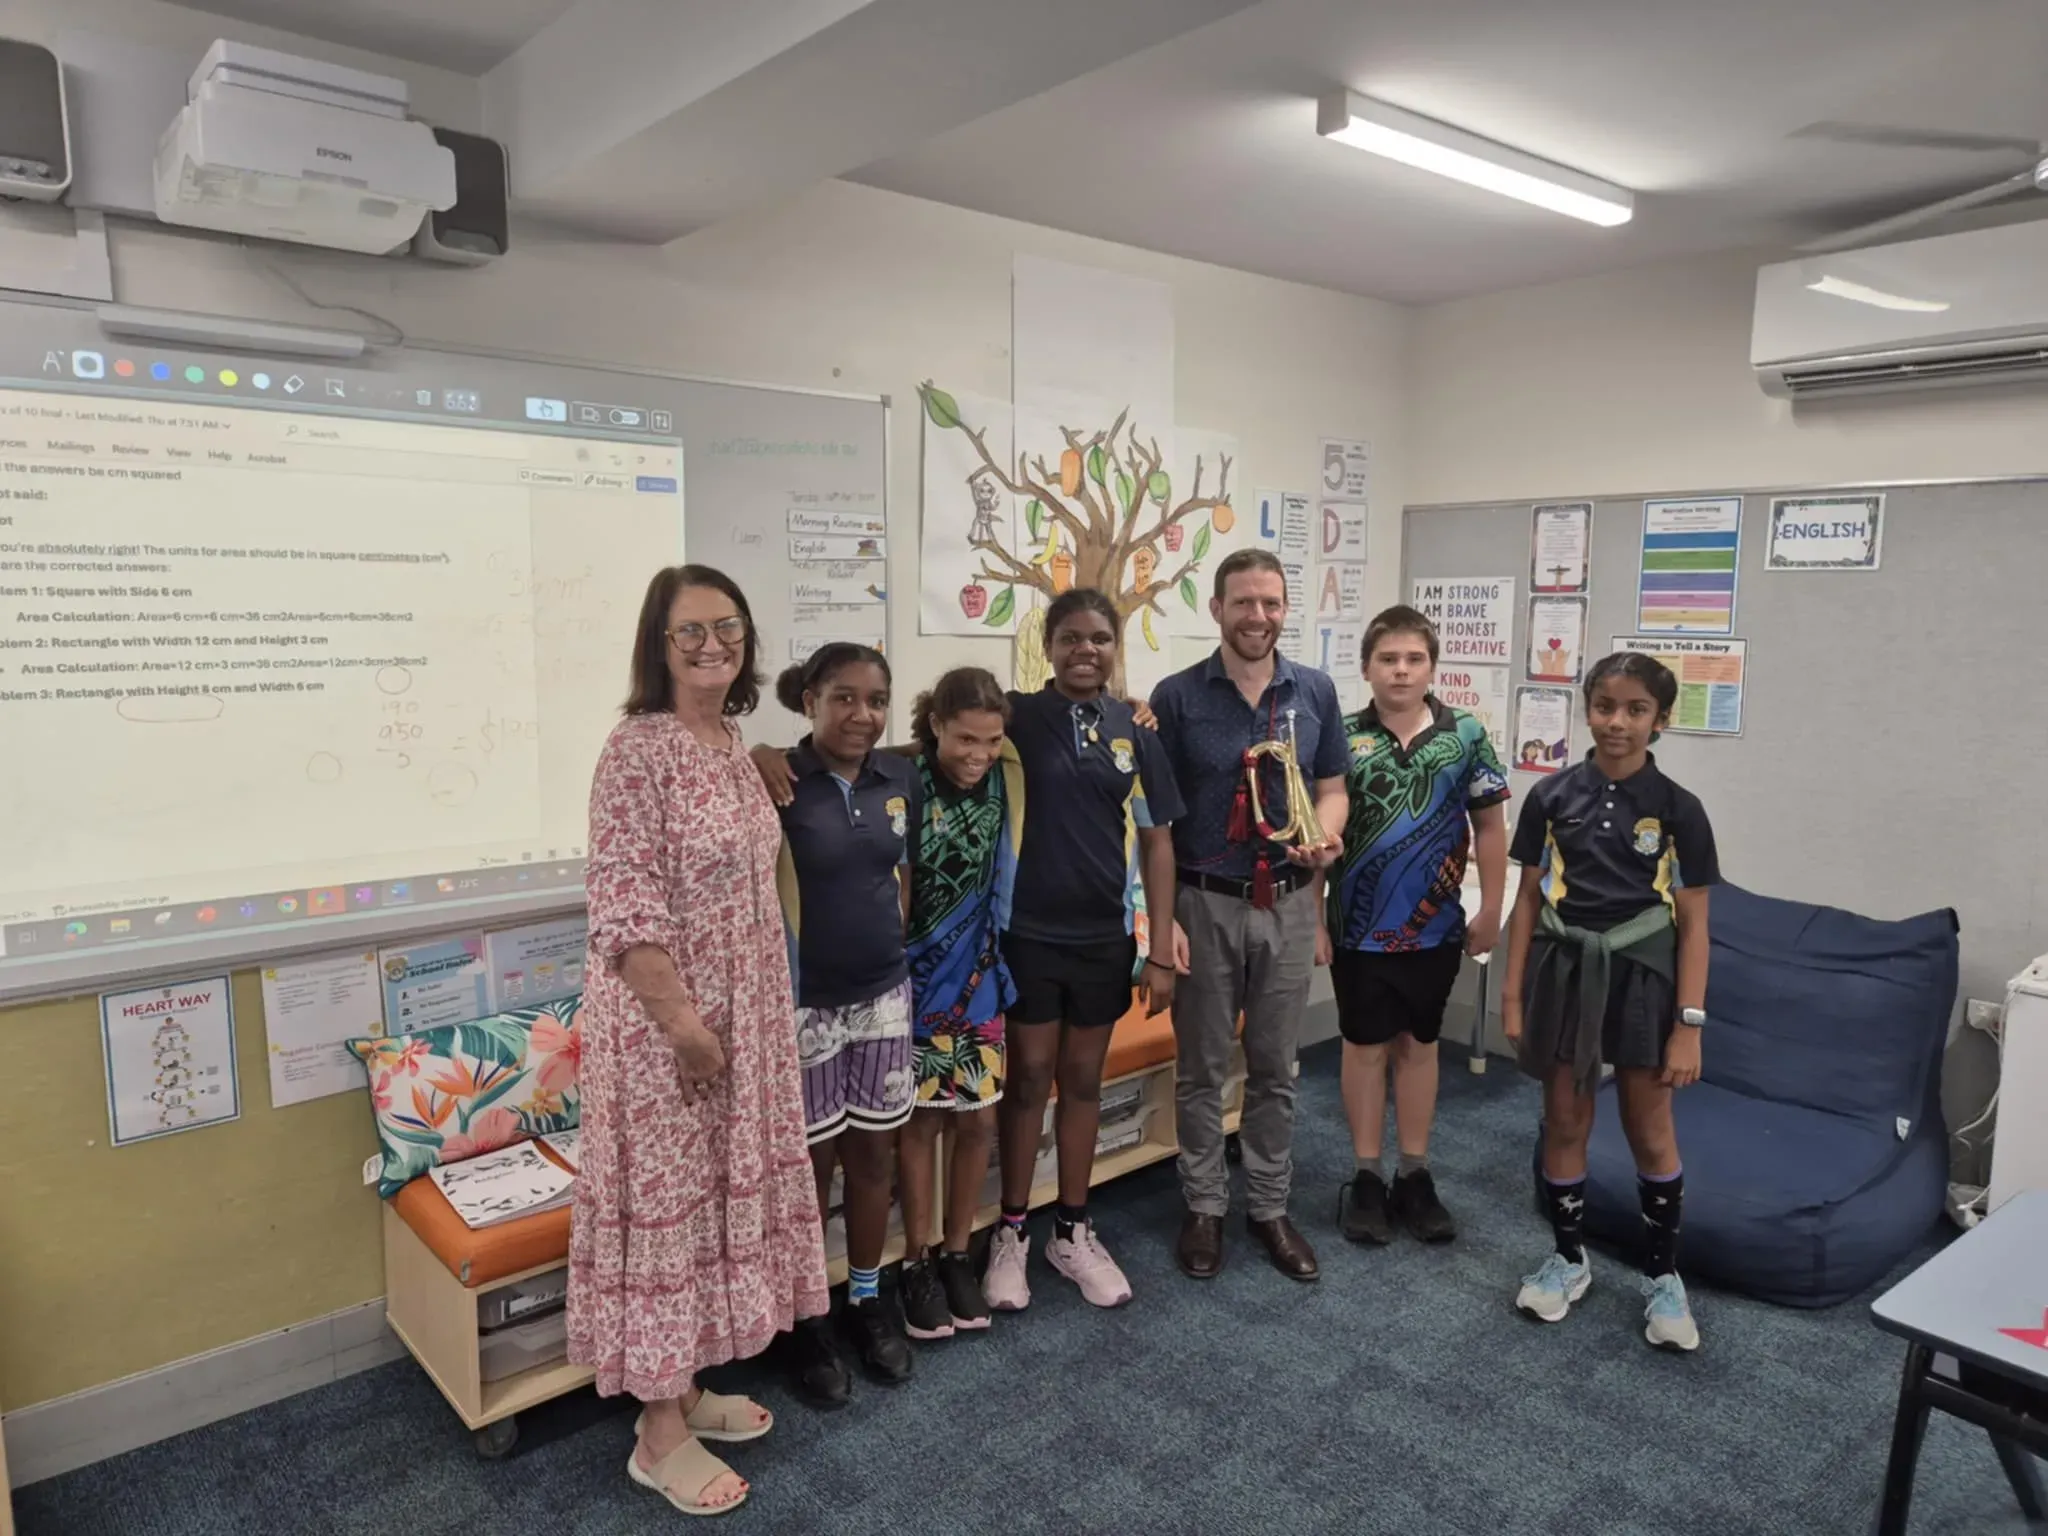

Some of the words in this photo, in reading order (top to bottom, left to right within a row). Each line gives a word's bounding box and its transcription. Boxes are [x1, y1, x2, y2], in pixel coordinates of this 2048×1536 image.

[316, 147, 352, 161] EPSON
[47, 441, 95, 454] Mailings
[112, 444, 149, 456] Review
[167, 447, 192, 457] View
[208, 450, 232, 462] Help
[248, 453, 286, 464] Acrobat
[5, 462, 27, 472] the
[30, 464, 86, 475] answers
[88, 467, 105, 477] be
[108, 469, 128, 478] cm
[131, 470, 181, 481] squared
[1324, 444, 1346, 491] 5
[14, 489, 48, 501] said:
[792, 513, 830, 531] Morning
[832, 515, 863, 530] Routine
[1260, 500, 1275, 539] L
[1323, 508, 1341, 553] D
[37, 543, 104, 557] absolutely
[144, 546, 166, 556] The
[169, 546, 199, 556] units
[201, 547, 217, 556] for
[220, 549, 246, 558] area
[250, 548, 288, 559] should
[290, 549, 304, 559] be
[306, 549, 317, 560] in
[319, 551, 356, 562] square
[793, 539, 827, 560] English
[1, 563, 22, 571] are
[26, 561, 46, 571] the
[50, 562, 113, 572] corrected
[116, 563, 172, 573] answers:
[46, 586, 95, 599] Square
[98, 586, 127, 597] with
[129, 586, 159, 597] Side
[172, 588, 193, 598] cm
[795, 584, 832, 601] Writing
[1319, 566, 1341, 612] A
[1415, 586, 1420, 600] I
[1424, 586, 1443, 600] AM
[1447, 585, 1499, 600] STRONG
[17, 612, 49, 623] Area
[52, 611, 136, 622] Calculation:
[1423, 604, 1442, 618] AM
[1446, 604, 1487, 618] BRAVE
[1446, 622, 1497, 637] HONEST
[35, 638, 49, 649] 2:
[51, 637, 119, 650] Rectangle
[122, 637, 150, 648] with
[153, 636, 192, 647] Width
[195, 636, 209, 646] 12
[212, 637, 232, 647] cm
[234, 635, 257, 646] and
[260, 635, 298, 647] Height
[310, 636, 328, 645] cm
[1626, 641, 1661, 651] Writing
[1663, 642, 1673, 650] to
[1674, 642, 1693, 651] Tell
[1703, 643, 1731, 653] Story
[21, 664, 54, 675] Area
[57, 662, 140, 674] Calculation:
[1440, 672, 1471, 687] KIND
[40, 688, 52, 700] 3:
[56, 687, 124, 700] Rectangle
[126, 686, 155, 698] with
[157, 685, 199, 697] Height
[212, 685, 232, 695] cm
[234, 682, 257, 693] and
[259, 681, 295, 693] Width
[306, 682, 324, 691] cm
[1440, 691, 1481, 706] LOVED
[122, 999, 174, 1018] HEART
[179, 992, 213, 1009] WAY
